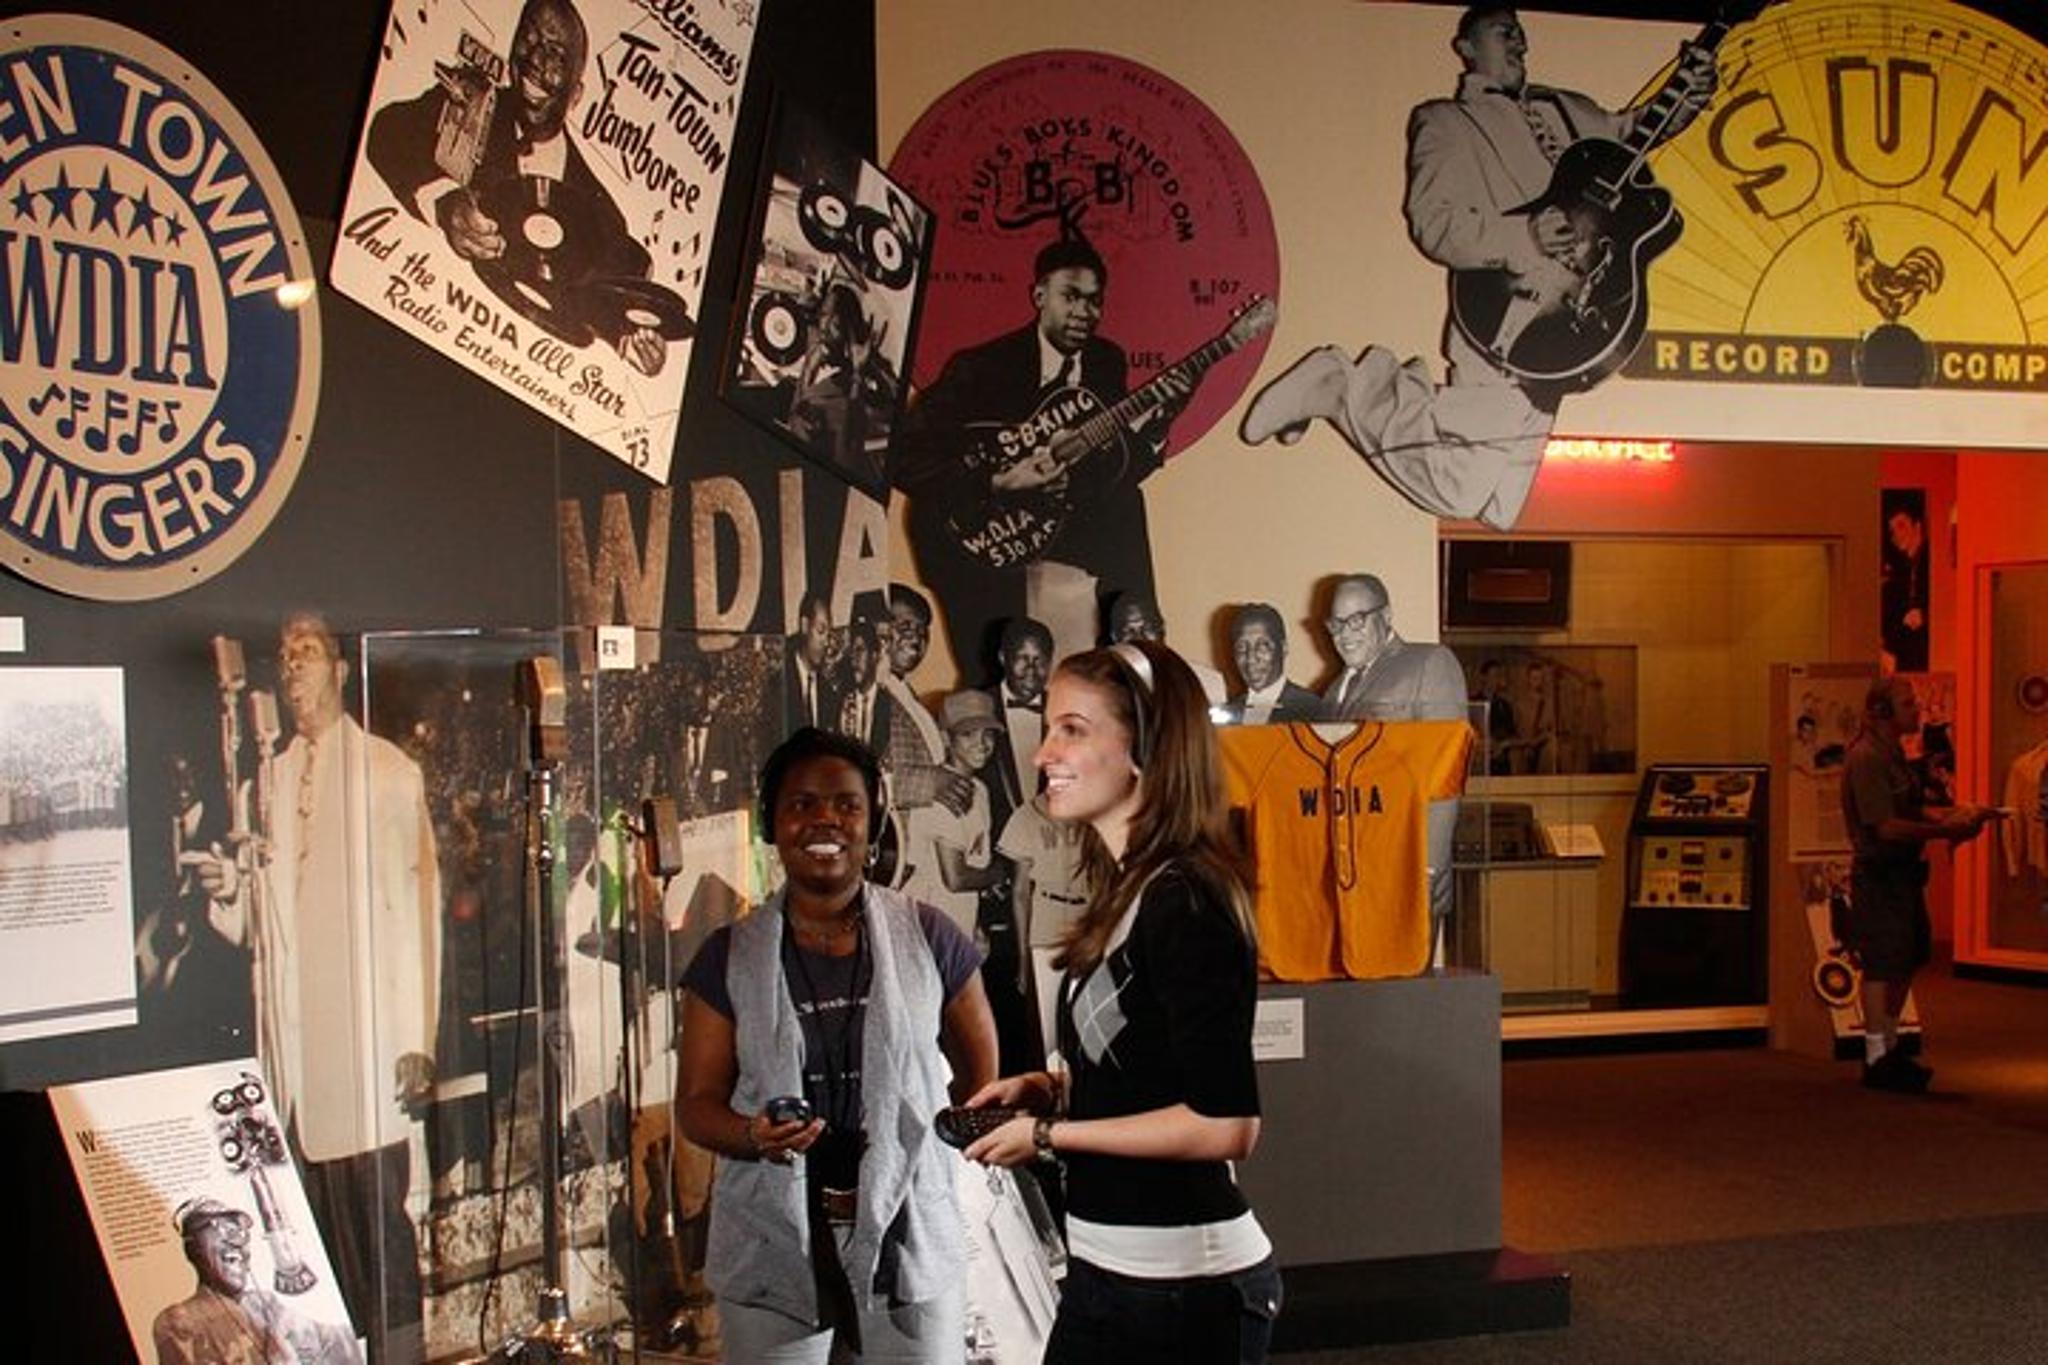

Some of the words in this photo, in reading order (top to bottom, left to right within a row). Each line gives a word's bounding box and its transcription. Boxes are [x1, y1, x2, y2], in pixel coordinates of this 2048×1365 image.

[113, 65, 287, 297] TOWN
[582, 79, 700, 214] Jamboree
[960, 142, 1013, 224] BLUES
[1022, 116, 1093, 146] BOYS
[1106, 124, 1194, 244] KINGDOM
[1707, 56, 2048, 256] SUN
[0, 229, 217, 390] WDIA
[343, 206, 401, 262] And
[401, 252, 437, 291] the
[445, 281, 520, 350] WDIA
[570, 364, 627, 419] Star
[383, 274, 448, 335] Radio
[453, 325, 577, 423] Entertainers
[1655, 341, 1830, 375] RECORD
[1942, 351, 2047, 382] COMP
[0, 420, 257, 562] SINGERS
[626, 436, 649, 467] 73
[559, 468, 890, 674] WDIA
[1299, 784, 1383, 817] WDIA
